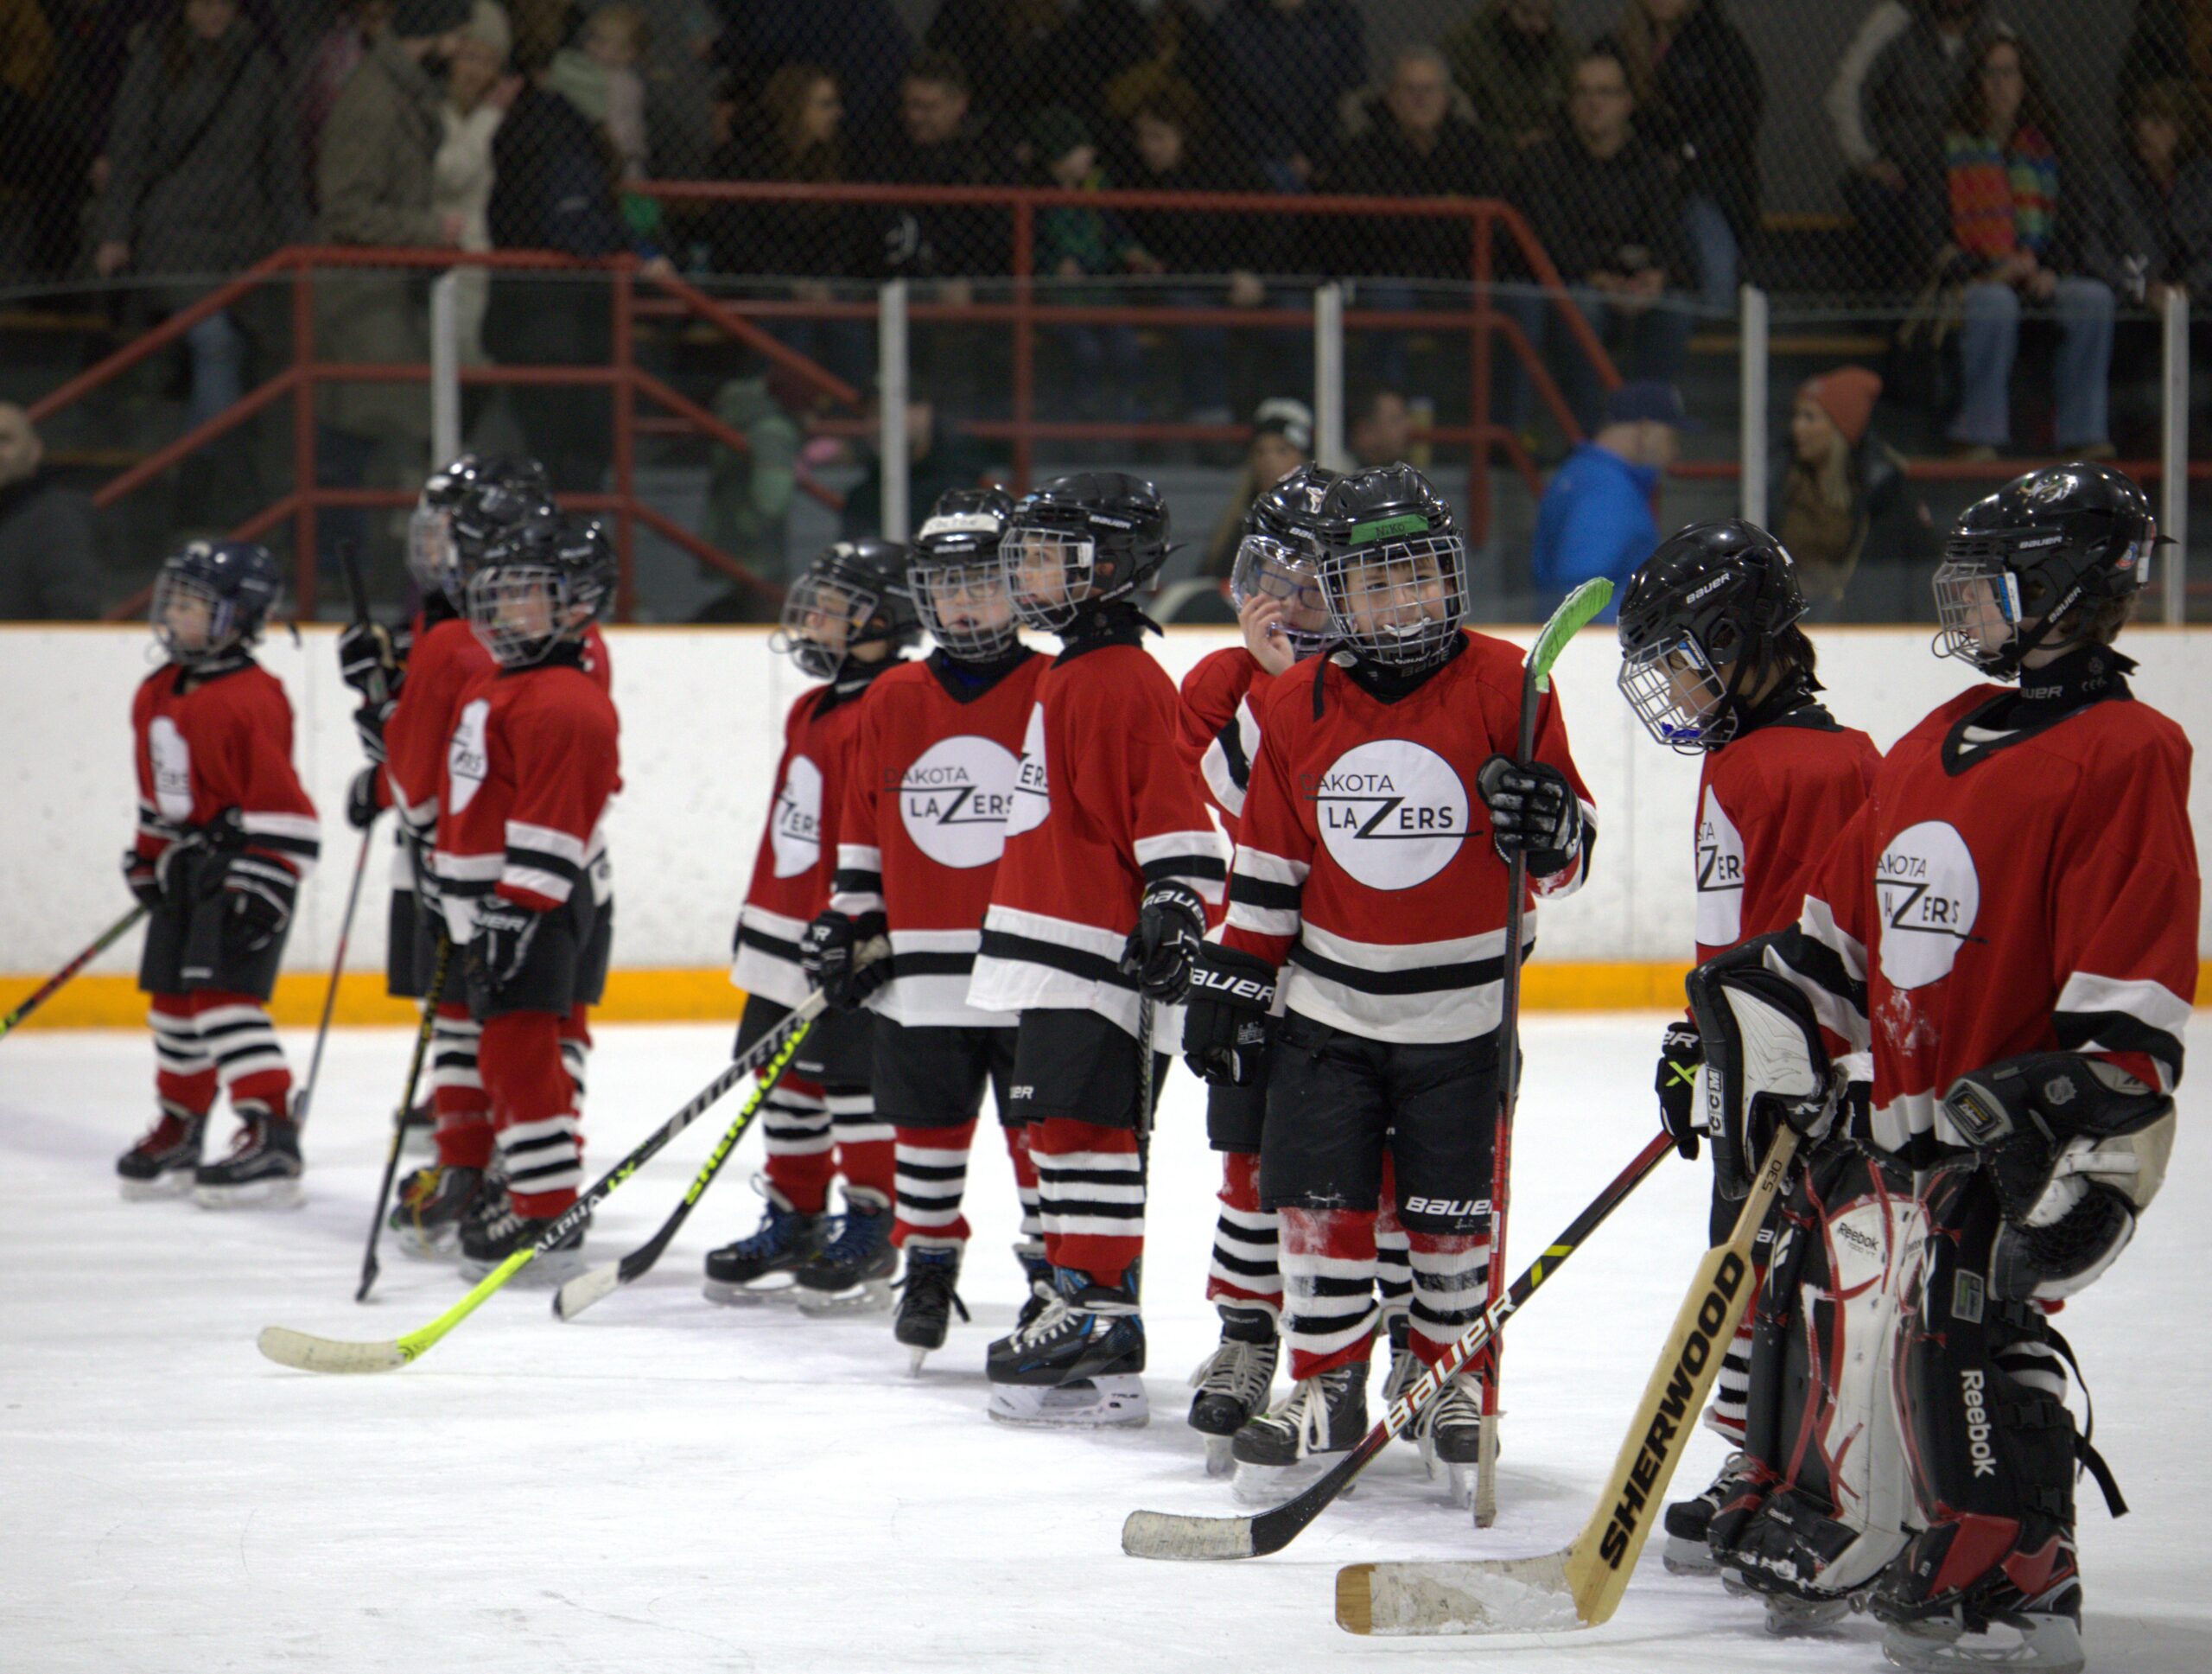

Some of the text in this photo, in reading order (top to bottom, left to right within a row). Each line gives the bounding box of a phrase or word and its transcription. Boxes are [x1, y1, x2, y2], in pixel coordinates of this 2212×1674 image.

[2018, 535, 2063, 550] BAUER
[1686, 572, 1730, 604] BAUER
[2048, 586, 2082, 623] BAUER
[1327, 796, 1454, 839] LAZERS
[1190, 967, 1275, 1003] AUER
[1707, 1067, 1725, 1132] CCM
[1762, 1158, 1783, 1193] 530
[532, 1195, 602, 1258] ALPHA
[1837, 1221, 1880, 1251] Reebok
[1382, 1289, 1517, 1439] BAUER
[1599, 1251, 1745, 1570] SHERWOOD
[1961, 1370, 1997, 1479] Reebok
